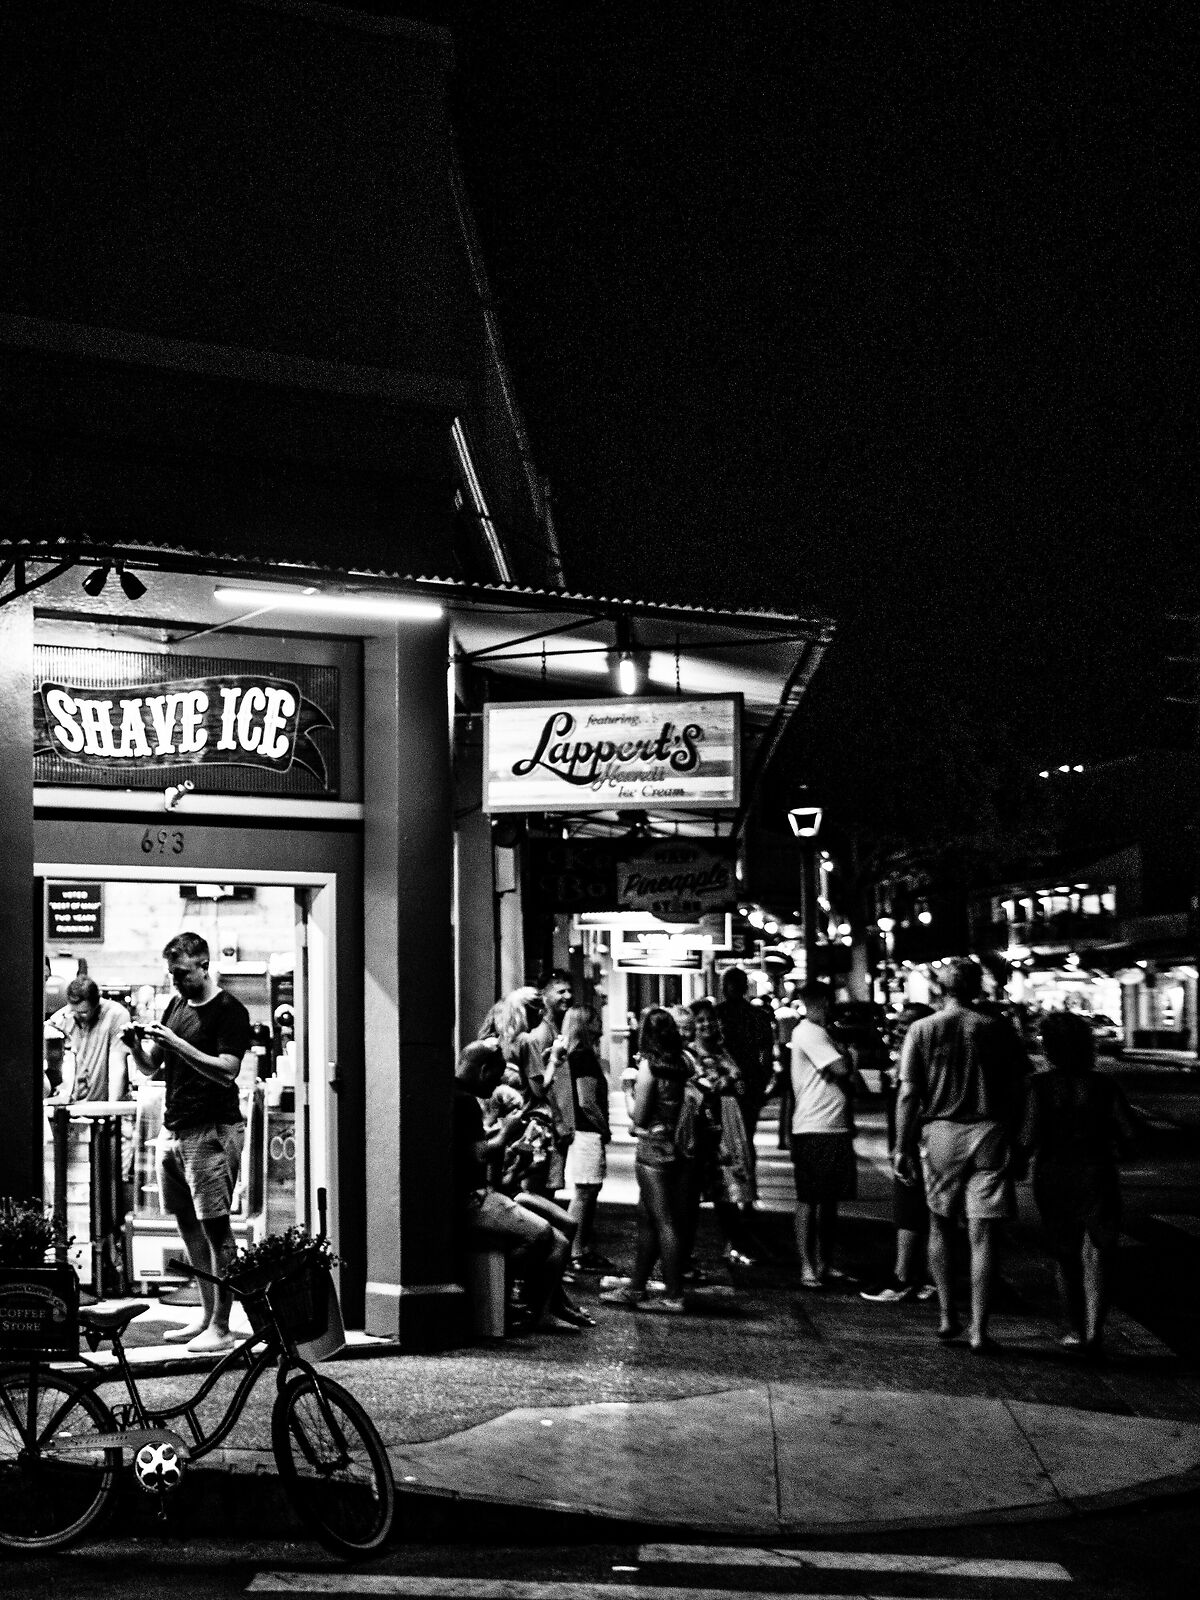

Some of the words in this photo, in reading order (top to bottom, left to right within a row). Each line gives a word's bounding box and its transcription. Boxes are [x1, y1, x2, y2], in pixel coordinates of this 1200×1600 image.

[46, 688, 209, 758] SHAVE
[216, 686, 296, 759] ICE
[140, 828, 186, 854] 693
[623, 862, 729, 897] Pineapple
[2, 1320, 41, 1332] STORE
